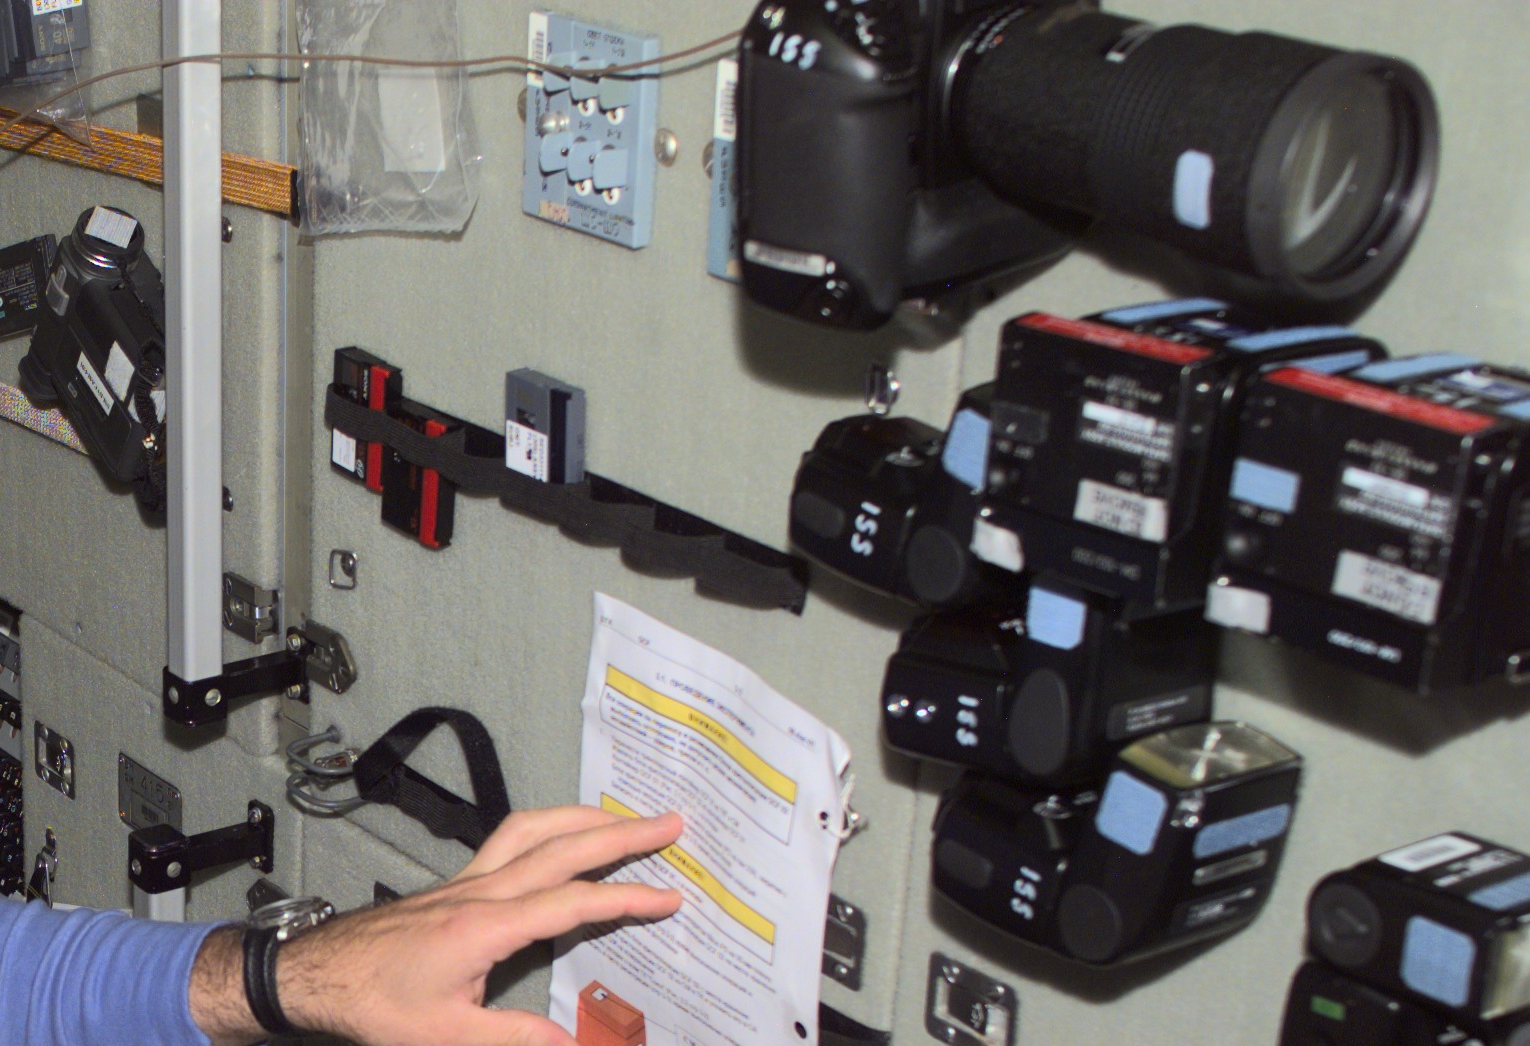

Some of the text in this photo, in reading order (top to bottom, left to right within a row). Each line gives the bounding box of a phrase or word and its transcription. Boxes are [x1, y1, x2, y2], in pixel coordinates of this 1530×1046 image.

[768, 31, 822, 71] ISS
[850, 501, 882, 557] ISS
[956, 694, 981, 748] ISS
[1010, 865, 1043, 921] ISS
